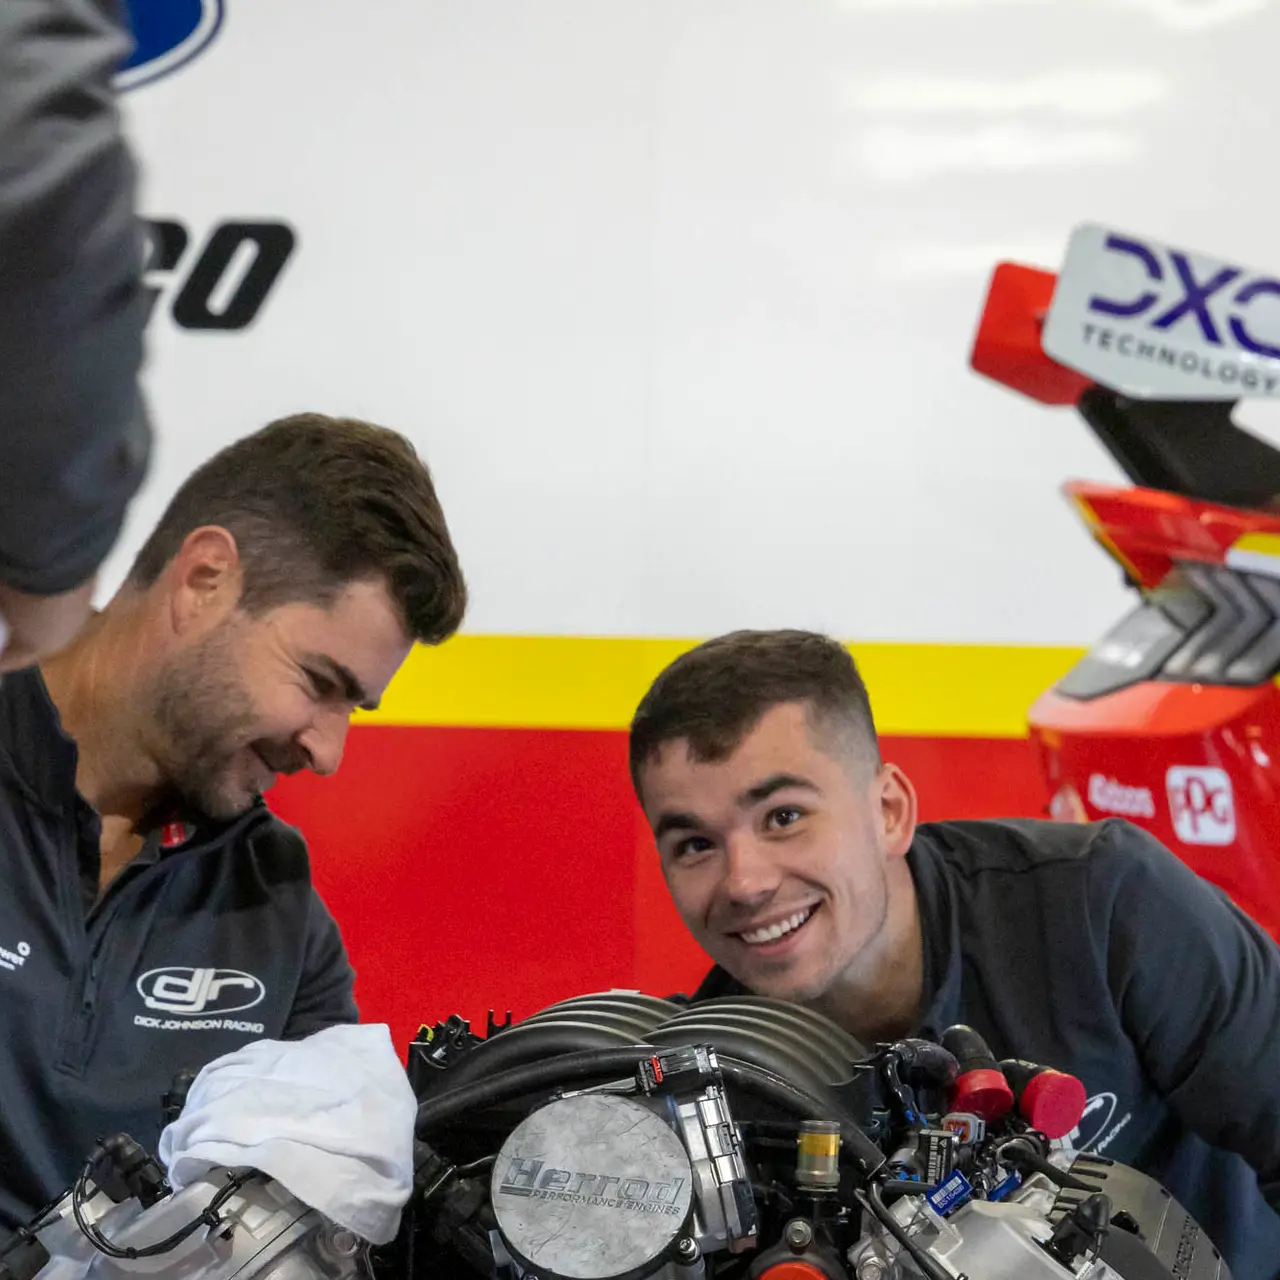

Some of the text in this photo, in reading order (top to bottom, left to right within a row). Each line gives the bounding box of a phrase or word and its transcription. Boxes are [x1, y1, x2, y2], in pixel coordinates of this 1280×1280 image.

[1081, 323, 1280, 396] TECHNOLOGY
[133, 1015, 265, 1034] DICK JOHNSON RACING
[501, 1157, 685, 1205] Herrod
[532, 1188, 681, 1216] PERFORMANCE ENGINES
